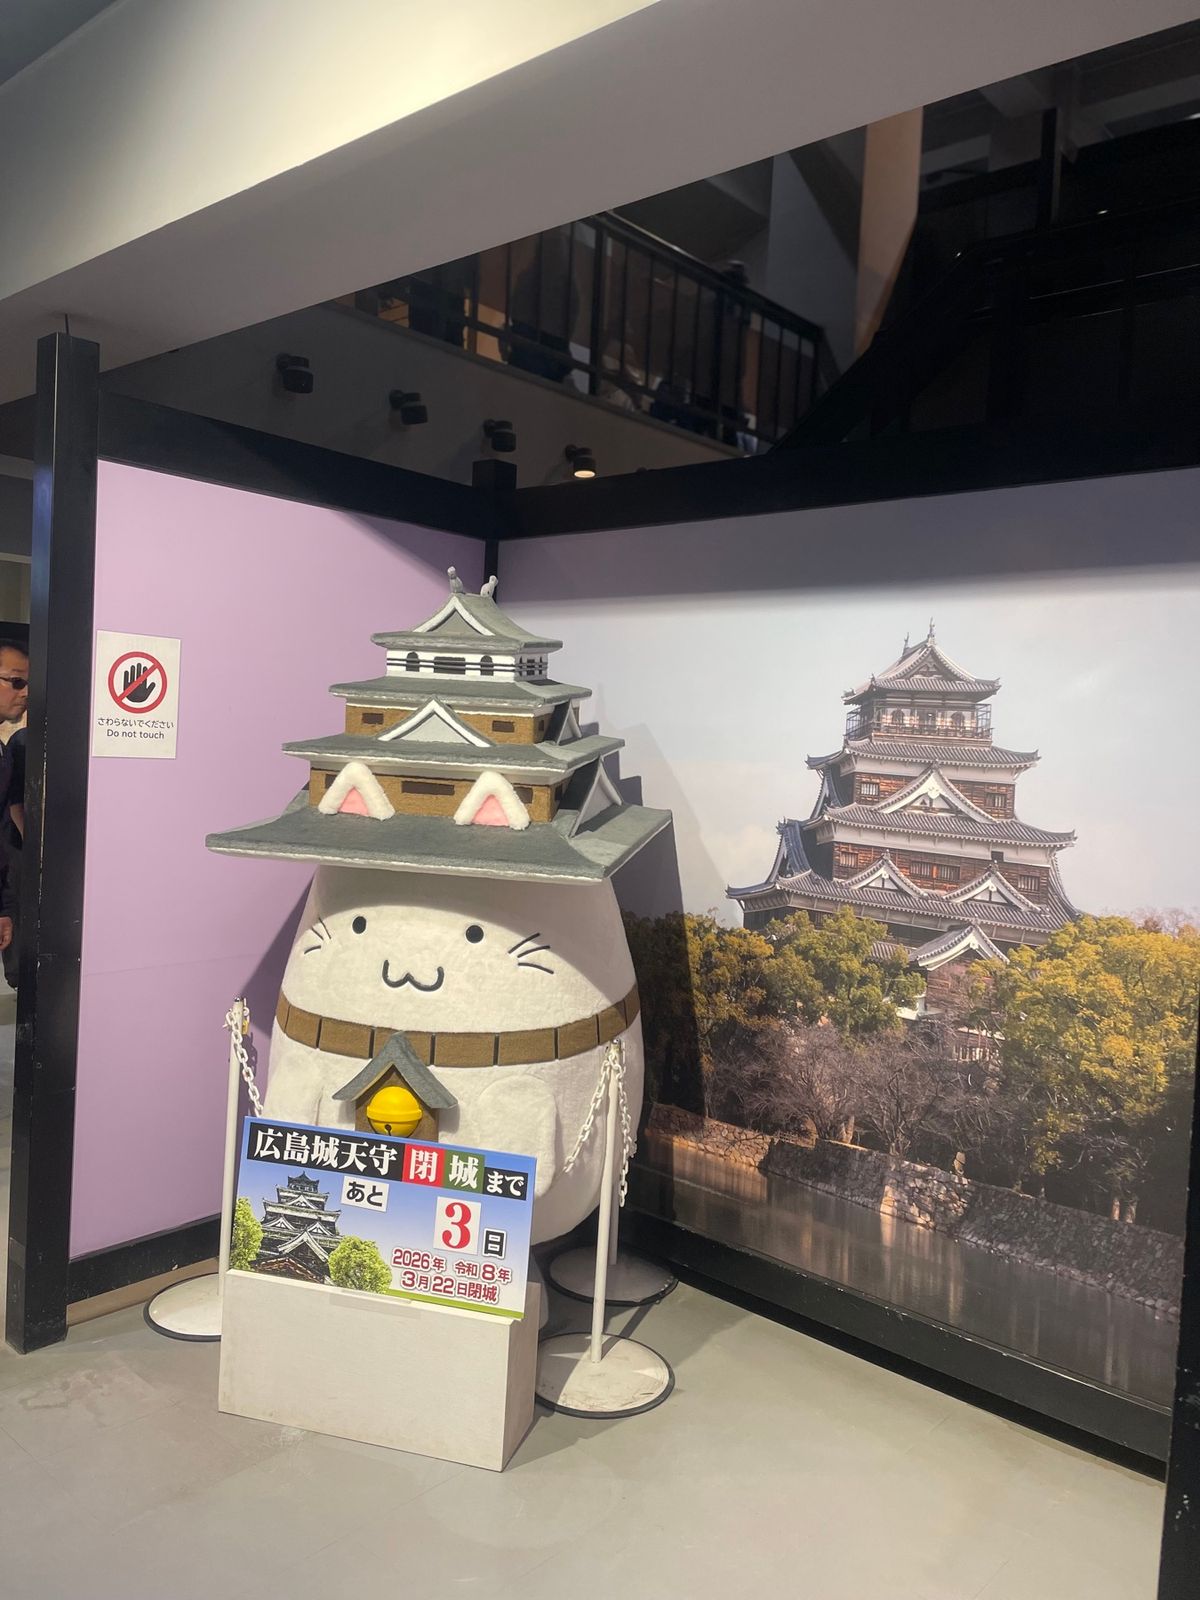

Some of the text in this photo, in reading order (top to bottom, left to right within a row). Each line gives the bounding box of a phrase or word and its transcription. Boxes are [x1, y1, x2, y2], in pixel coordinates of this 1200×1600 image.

[98, 718, 174, 728] さわらないでください
[107, 729, 164, 739] Do not touch
[346, 1181, 384, 1207] あと
[392, 1249, 511, 1283] 2026年 令和8年
[402, 1271, 498, 1303] 3月22日閉城
